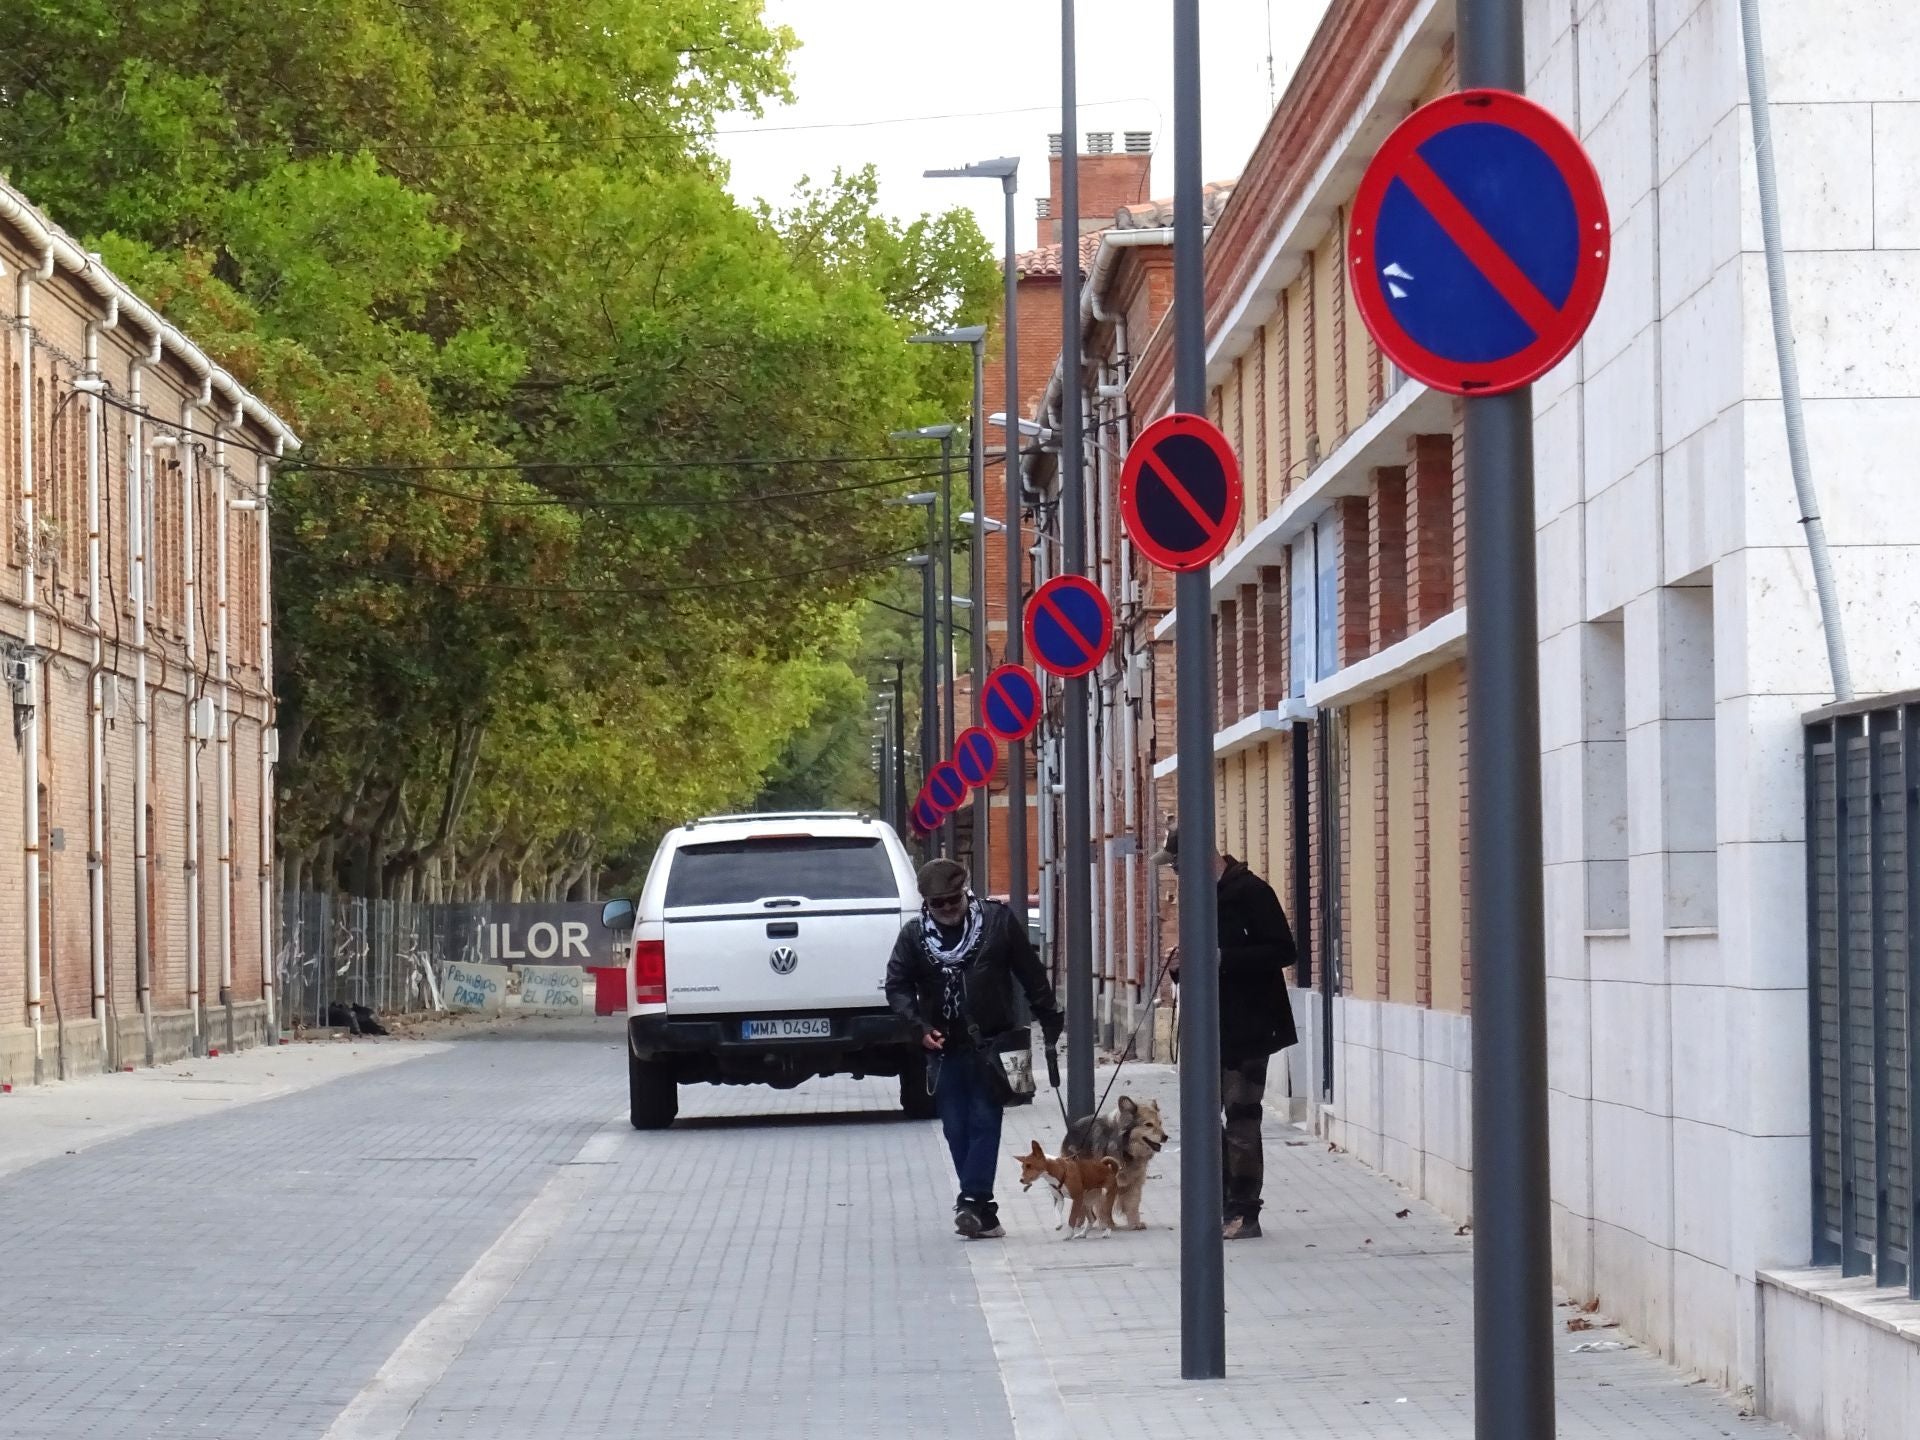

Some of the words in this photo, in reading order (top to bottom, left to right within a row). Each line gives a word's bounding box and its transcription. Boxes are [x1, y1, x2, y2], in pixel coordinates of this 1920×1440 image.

[489, 921, 591, 959] ILOR
[447, 964, 497, 993] PROHIBIDO
[522, 966, 579, 988] PROHIBIDO
[453, 985, 486, 1008] PASAR
[522, 989, 539, 1004] EL
[544, 989, 579, 1006] PASO
[750, 1022, 778, 1037] MMA
[783, 1020, 830, 1035] 04948
